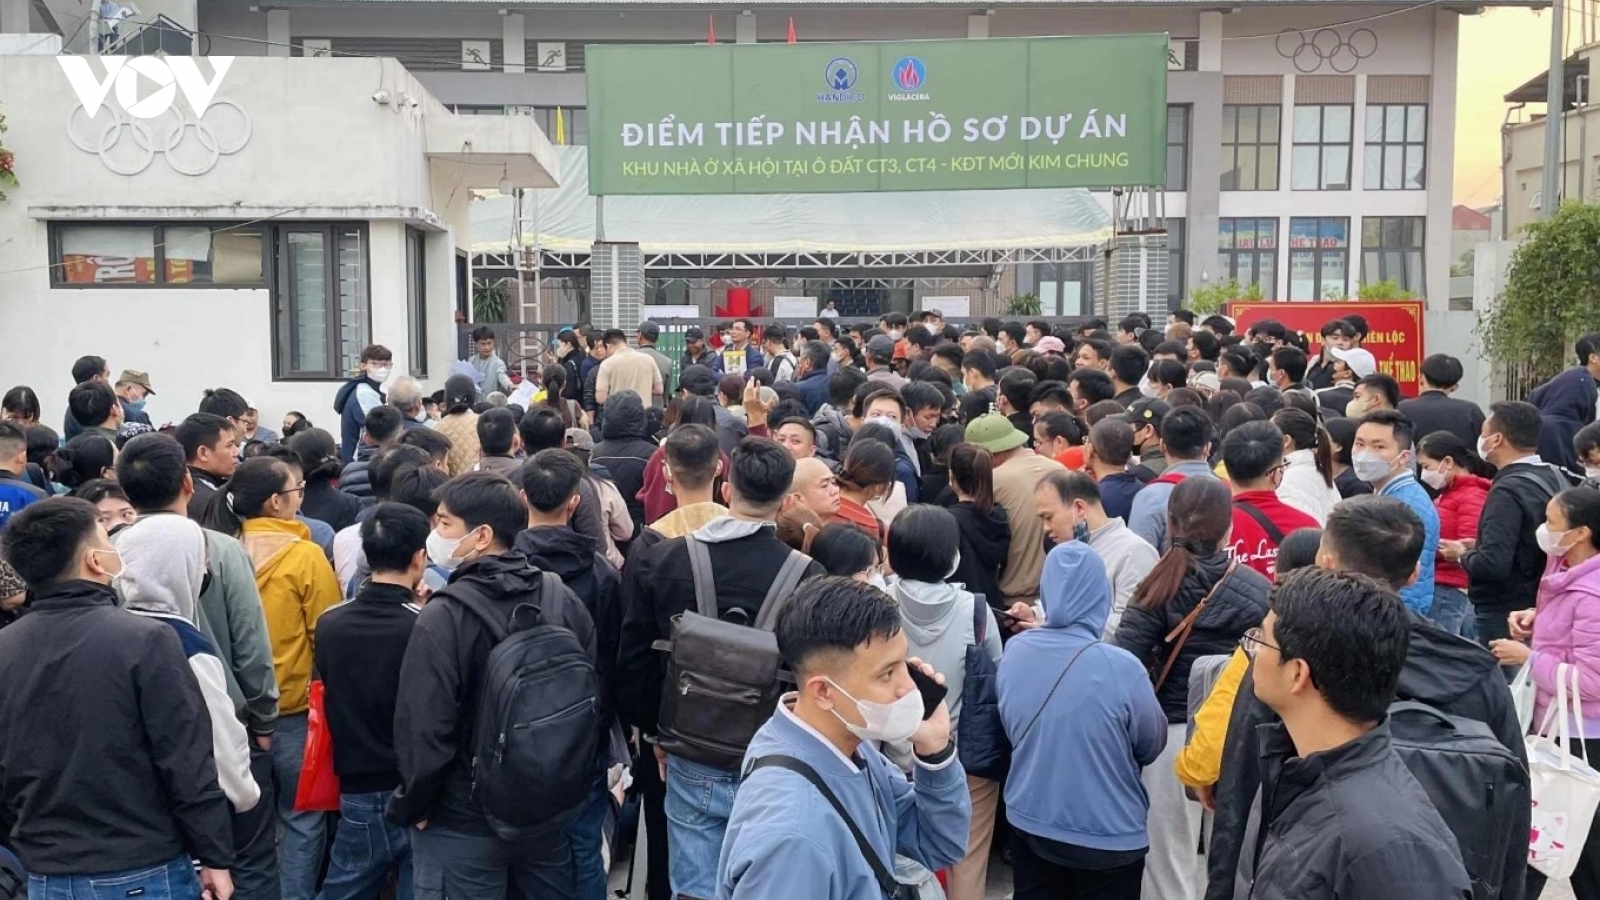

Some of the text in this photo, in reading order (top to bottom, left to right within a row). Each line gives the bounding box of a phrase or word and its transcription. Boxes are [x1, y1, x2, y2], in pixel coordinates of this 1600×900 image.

[888, 93, 930, 101] VIGLACERA
[621, 108, 1127, 150] ĐIỂM TIẾP NHẬN HỒ SƠ DỰ ÁN
[623, 161, 659, 176] KHU
[664, 157, 701, 176] NHÀ
[704, 158, 719, 175] Ở
[722, 157, 746, 175] XÃ
[749, 157, 780, 177] HỘI
[783, 160, 807, 177] TẠI
[813, 156, 826, 174] Ô
[830, 155, 864, 173] ĐẤT
[867, 159, 901, 174] CT3,
[905, 157, 936, 172] CT4
[951, 156, 985, 171] KĐT
[989, 152, 1024, 170] MỚI
[1029, 154, 1060, 169] KIM
[1065, 152, 1128, 168] CHUNG
[1386, 330, 1405, 345] LỘC
[1223, 538, 1249, 564] The
